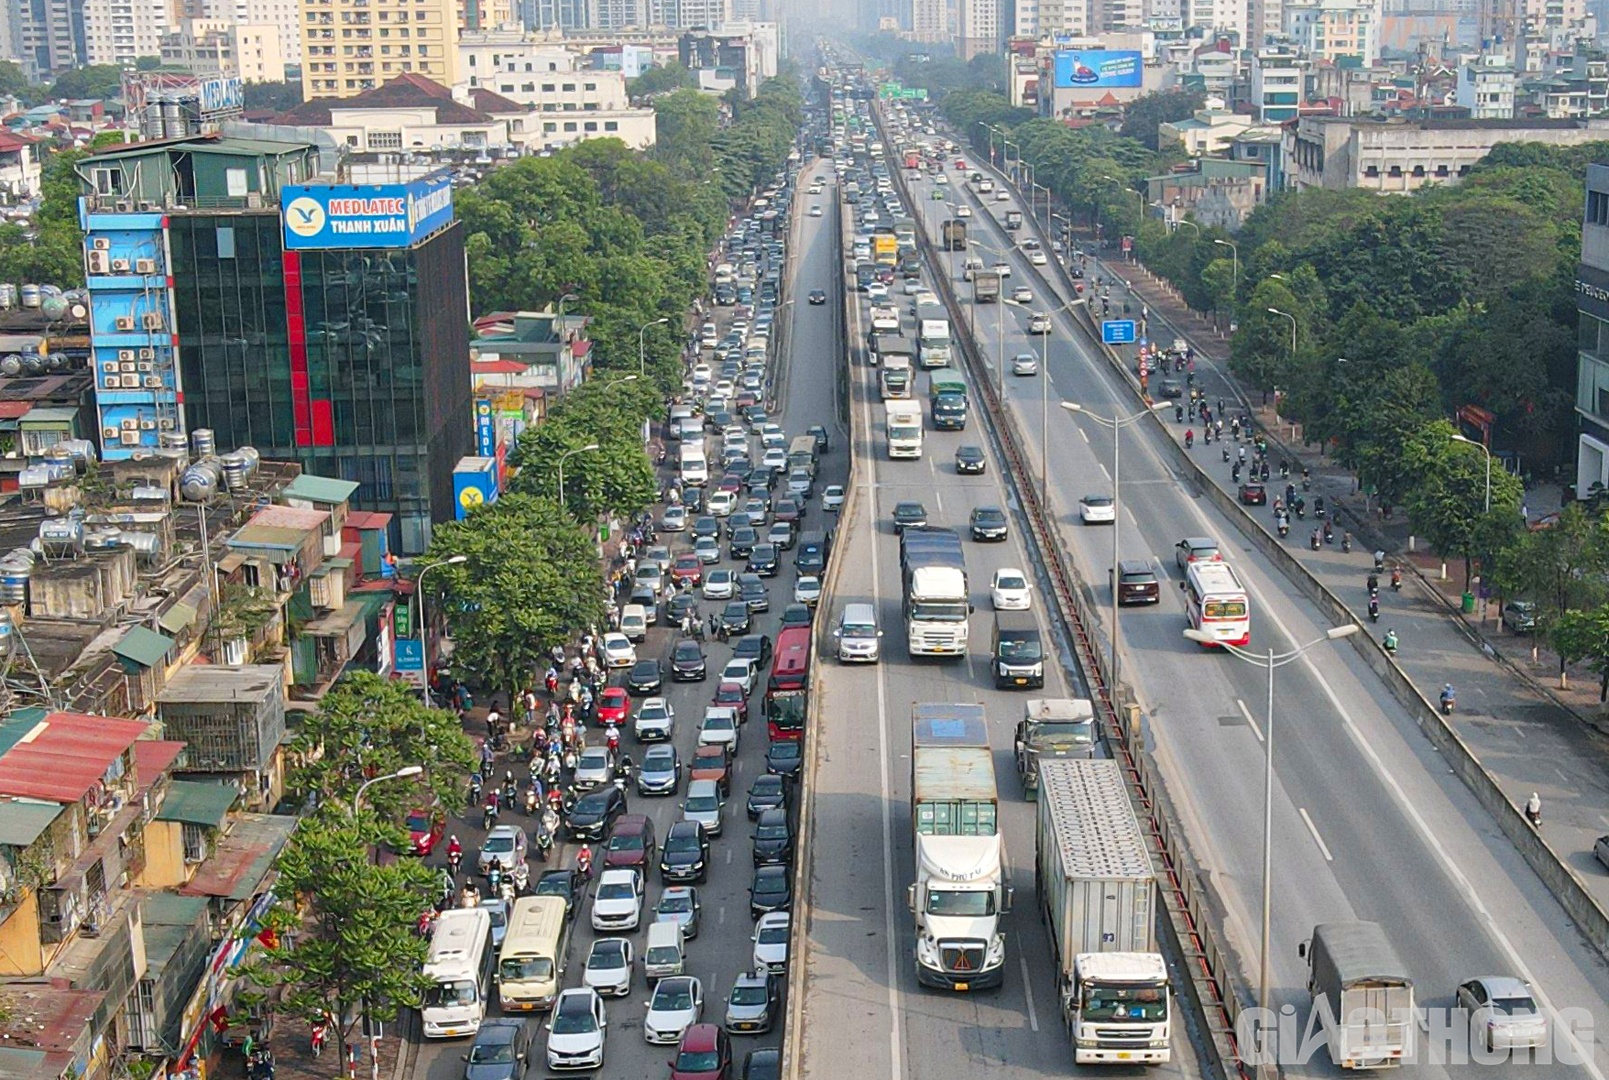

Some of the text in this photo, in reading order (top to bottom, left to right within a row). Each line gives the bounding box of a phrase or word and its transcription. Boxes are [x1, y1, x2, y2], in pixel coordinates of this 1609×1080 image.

[328, 197, 405, 216] MEDLATEC
[330, 217, 406, 234] THANH XUÂN
